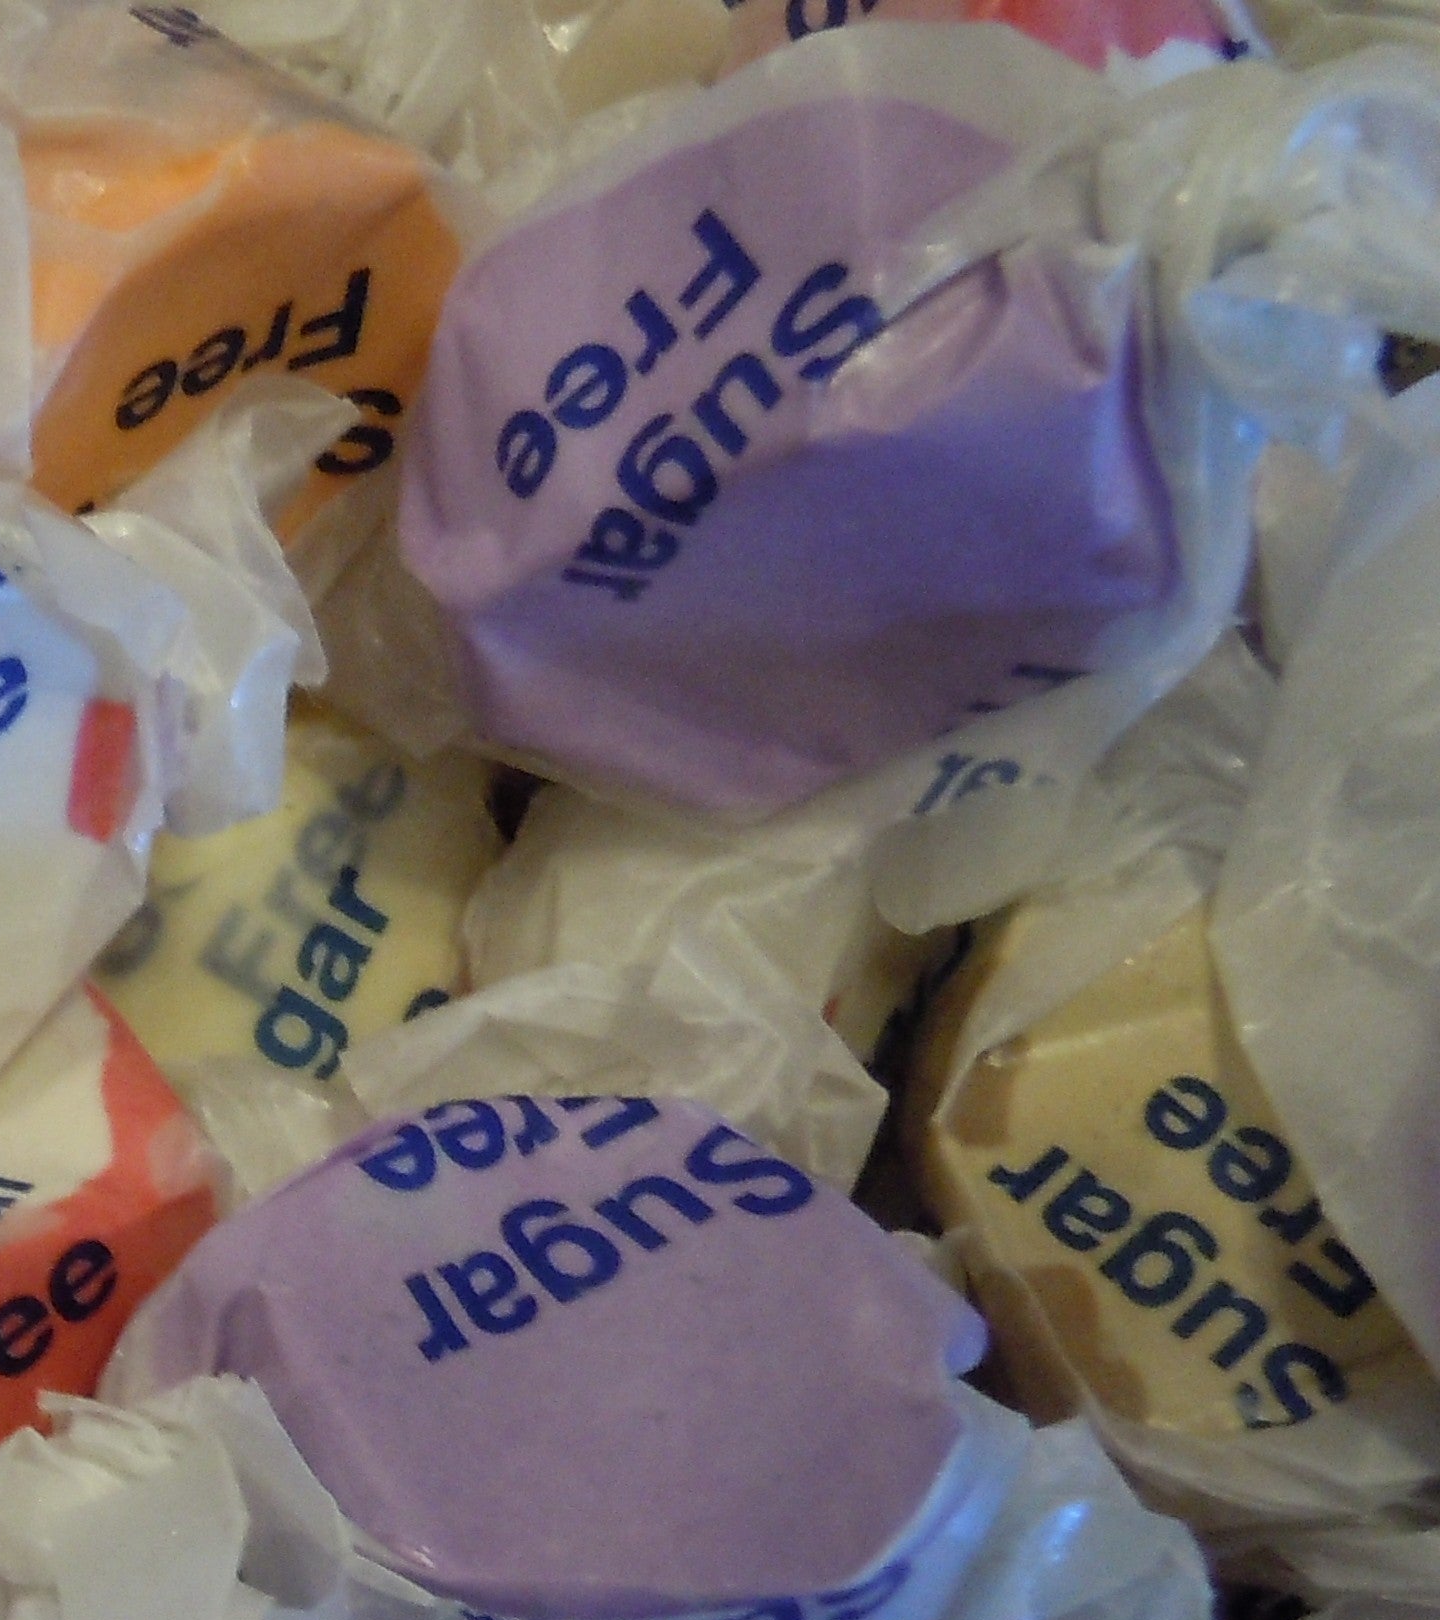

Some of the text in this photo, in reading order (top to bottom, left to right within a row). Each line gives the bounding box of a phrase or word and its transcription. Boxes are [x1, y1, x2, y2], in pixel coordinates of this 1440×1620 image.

[115, 267, 370, 430] Free
[496, 208, 762, 501] Free
[561, 262, 884, 602] Sugar
[253, 865, 390, 1082] gar
[404, 1125, 814, 1363] Sugar
[987, 1146, 1348, 1430] Sugar
